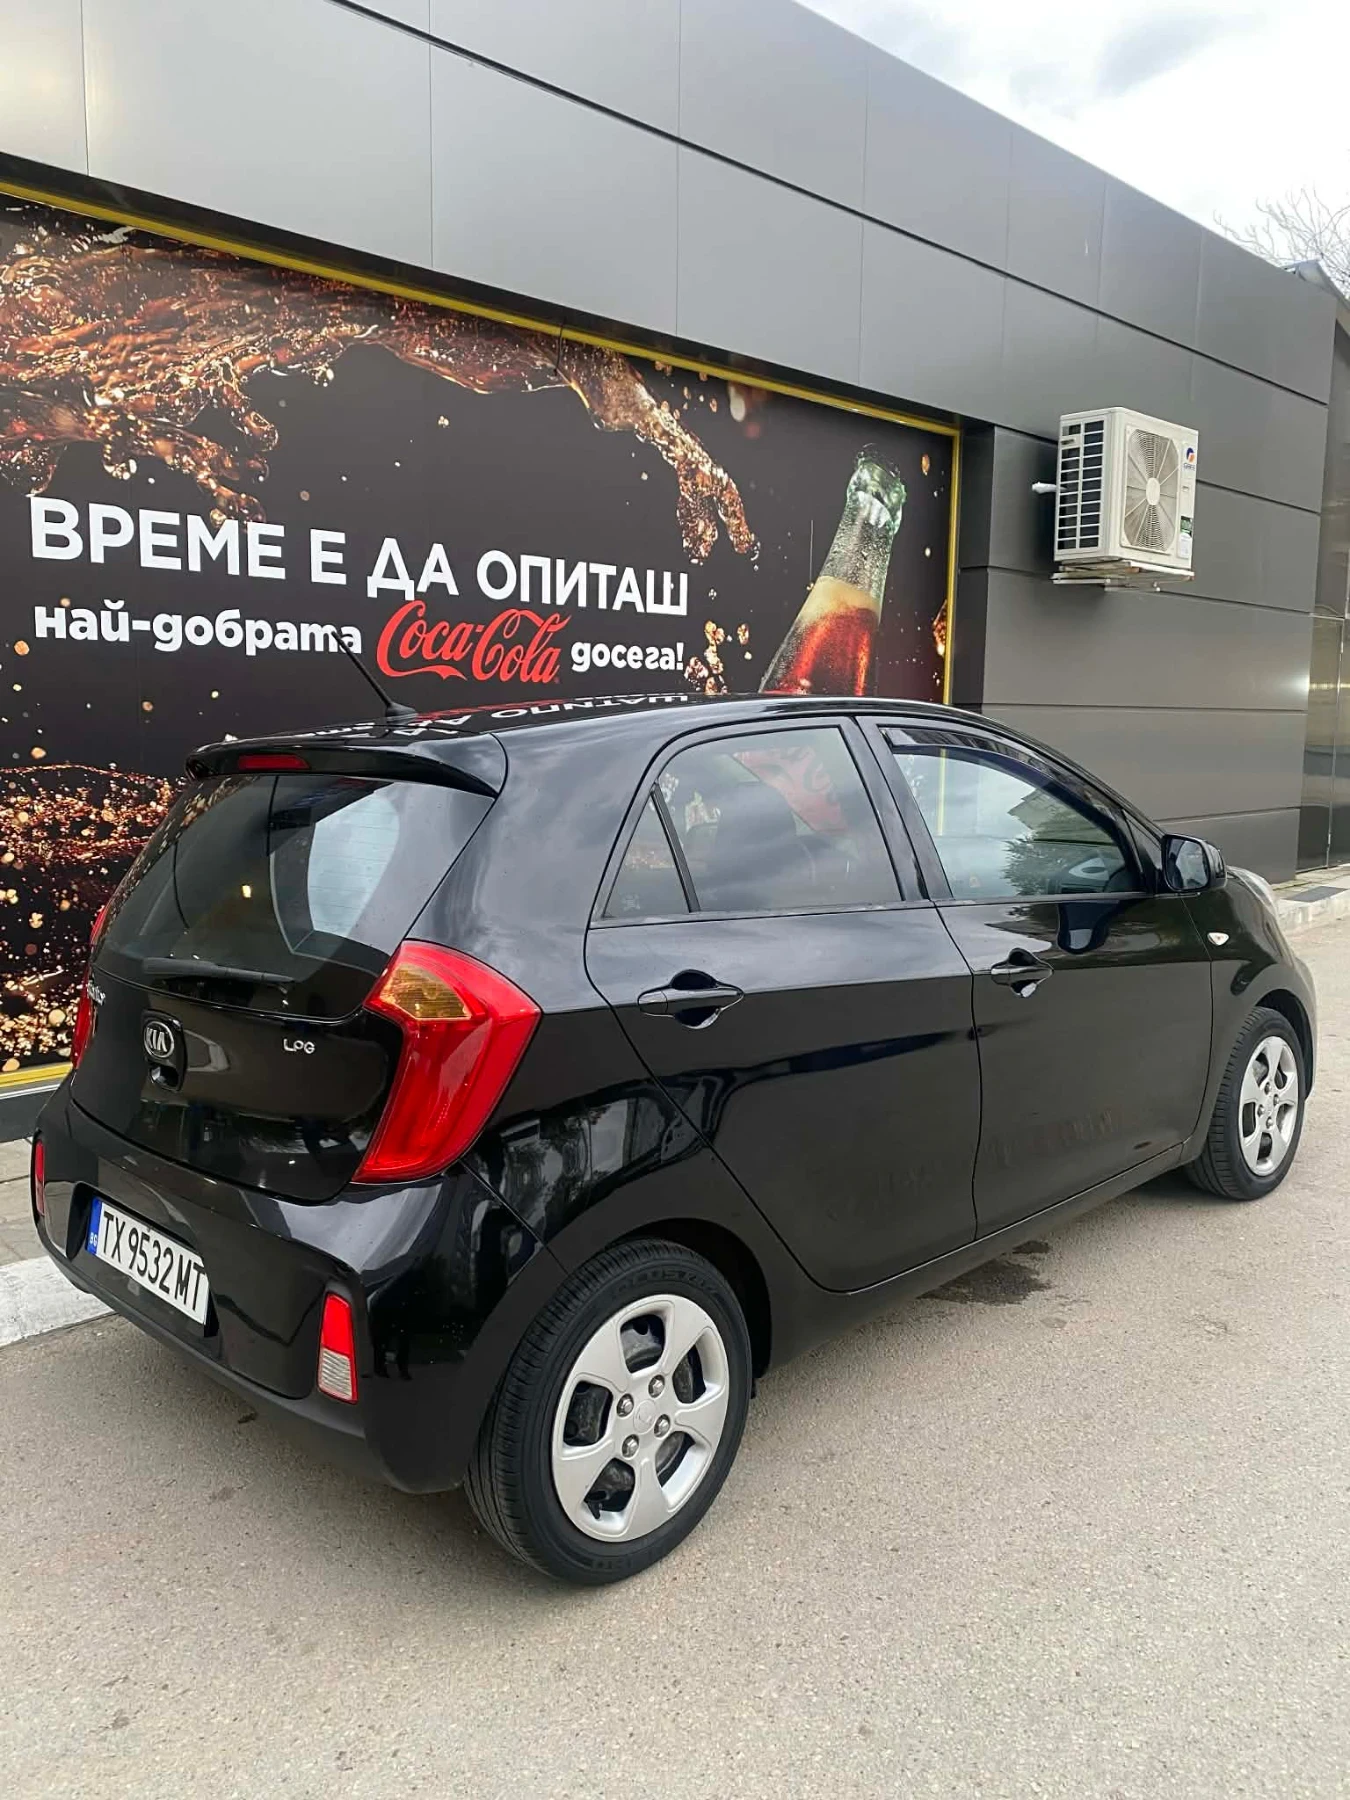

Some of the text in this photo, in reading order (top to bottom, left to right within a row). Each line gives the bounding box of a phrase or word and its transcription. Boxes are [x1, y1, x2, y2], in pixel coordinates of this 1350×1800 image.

[30, 496, 689, 616] ВРЕМЕ Е ДА ОПИТАШ
[35, 599, 685, 684] най-добрата Coca-Cola досега!
[145, 1025, 169, 1054] KIA
